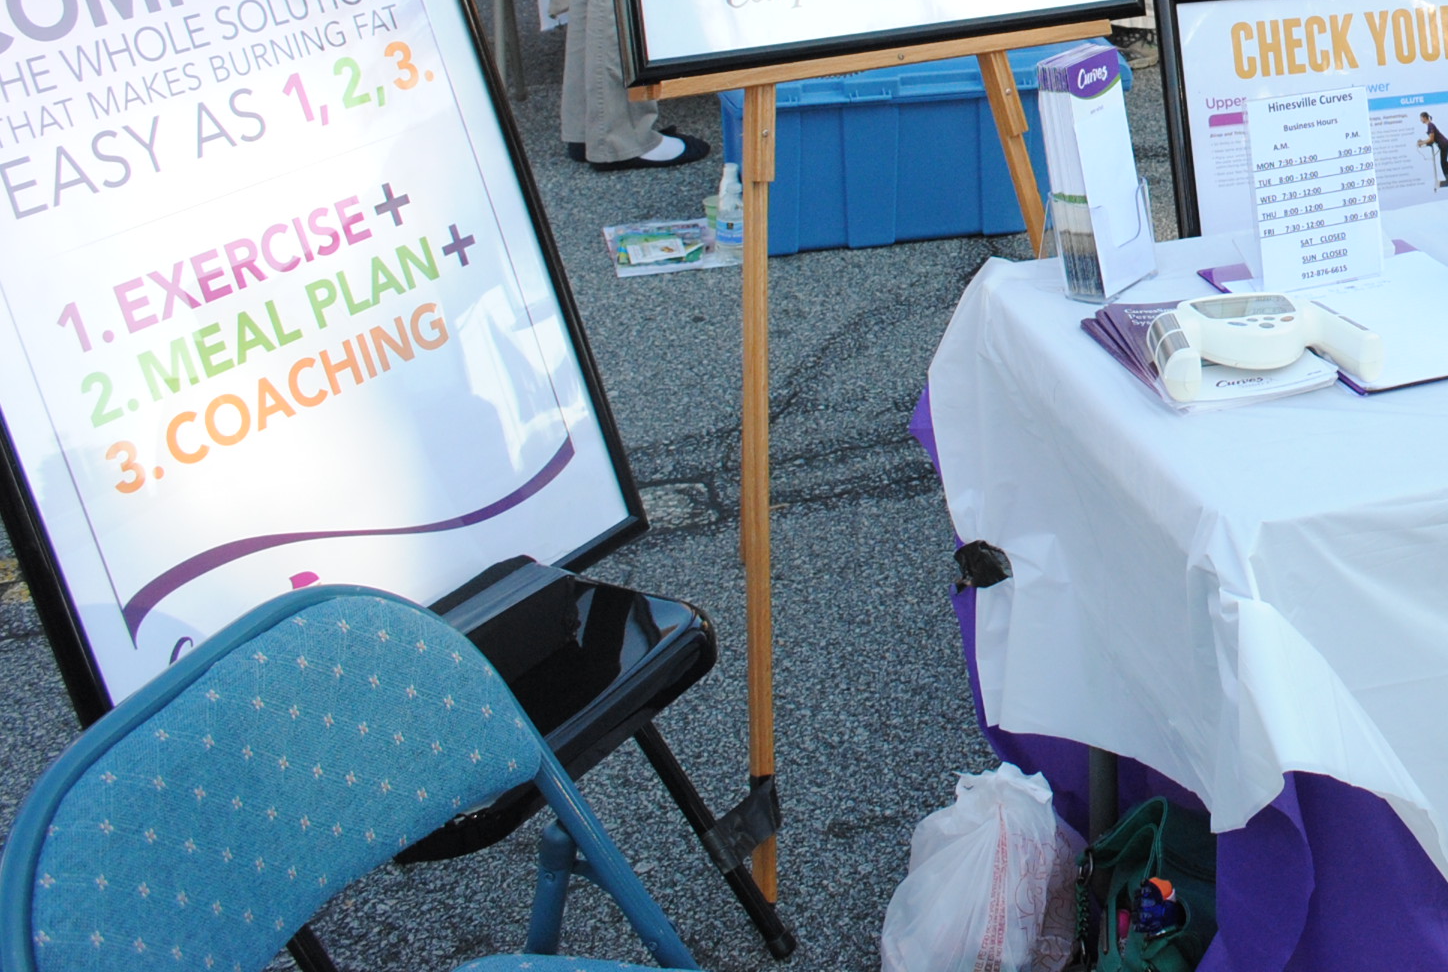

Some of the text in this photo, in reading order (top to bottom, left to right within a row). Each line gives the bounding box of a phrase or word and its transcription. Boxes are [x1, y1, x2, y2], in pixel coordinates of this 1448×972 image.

[58, 12, 211, 82] WHOLE
[1231, 13, 1359, 79] CHECK
[0, 3, 400, 149] HAT MAKES BURNING FAT
[1077, 65, 1108, 90] Curves
[1205, 96, 1247, 111] Upper
[1268, 93, 1353, 113] Hinesville Curves
[1400, 96, 1425, 105] GLUTE
[0, 40, 435, 220] EASY AS 1, 2, 3.
[1283, 117, 1338, 132] Business Hours
[1345, 131, 1361, 139] P.M.
[1273, 142, 1290, 151] A.M.
[1256, 162, 1275, 170] MON
[1278, 158, 1294, 167] 7:30
[1299, 154, 1318, 164] 12:00
[1338, 148, 1353, 158] 3:00
[1258, 178, 1272, 187] TUE
[1278, 174, 1295, 184] 8:00
[1300, 170, 1319, 181] 12:00
[1339, 164, 1355, 174] 3:00
[1260, 194, 1277, 204] WED
[1282, 191, 1298, 201] 7:30
[1303, 187, 1322, 197] 12:00
[1341, 181, 1356, 190] 3:00
[1262, 194, 1377, 221] THU 8:00 12:00 3:00 7:00
[1263, 228, 1275, 237] FRI
[1285, 223, 1301, 233] 7:30
[1306, 219, 1325, 230] 12:00
[1344, 213, 1359, 223] 3:00
[1300, 232, 1347, 248] SAT CLOSED
[1302, 248, 1348, 264] SUN CLOSED
[1301, 264, 1348, 280] 912-876-6615
[57, 301, 115, 353] 1.
[80, 370, 140, 429] 2.
[137, 299, 304, 402] MEAL
[1215, 376, 1264, 389] Curves
[104, 302, 450, 494] 3. COACHING
